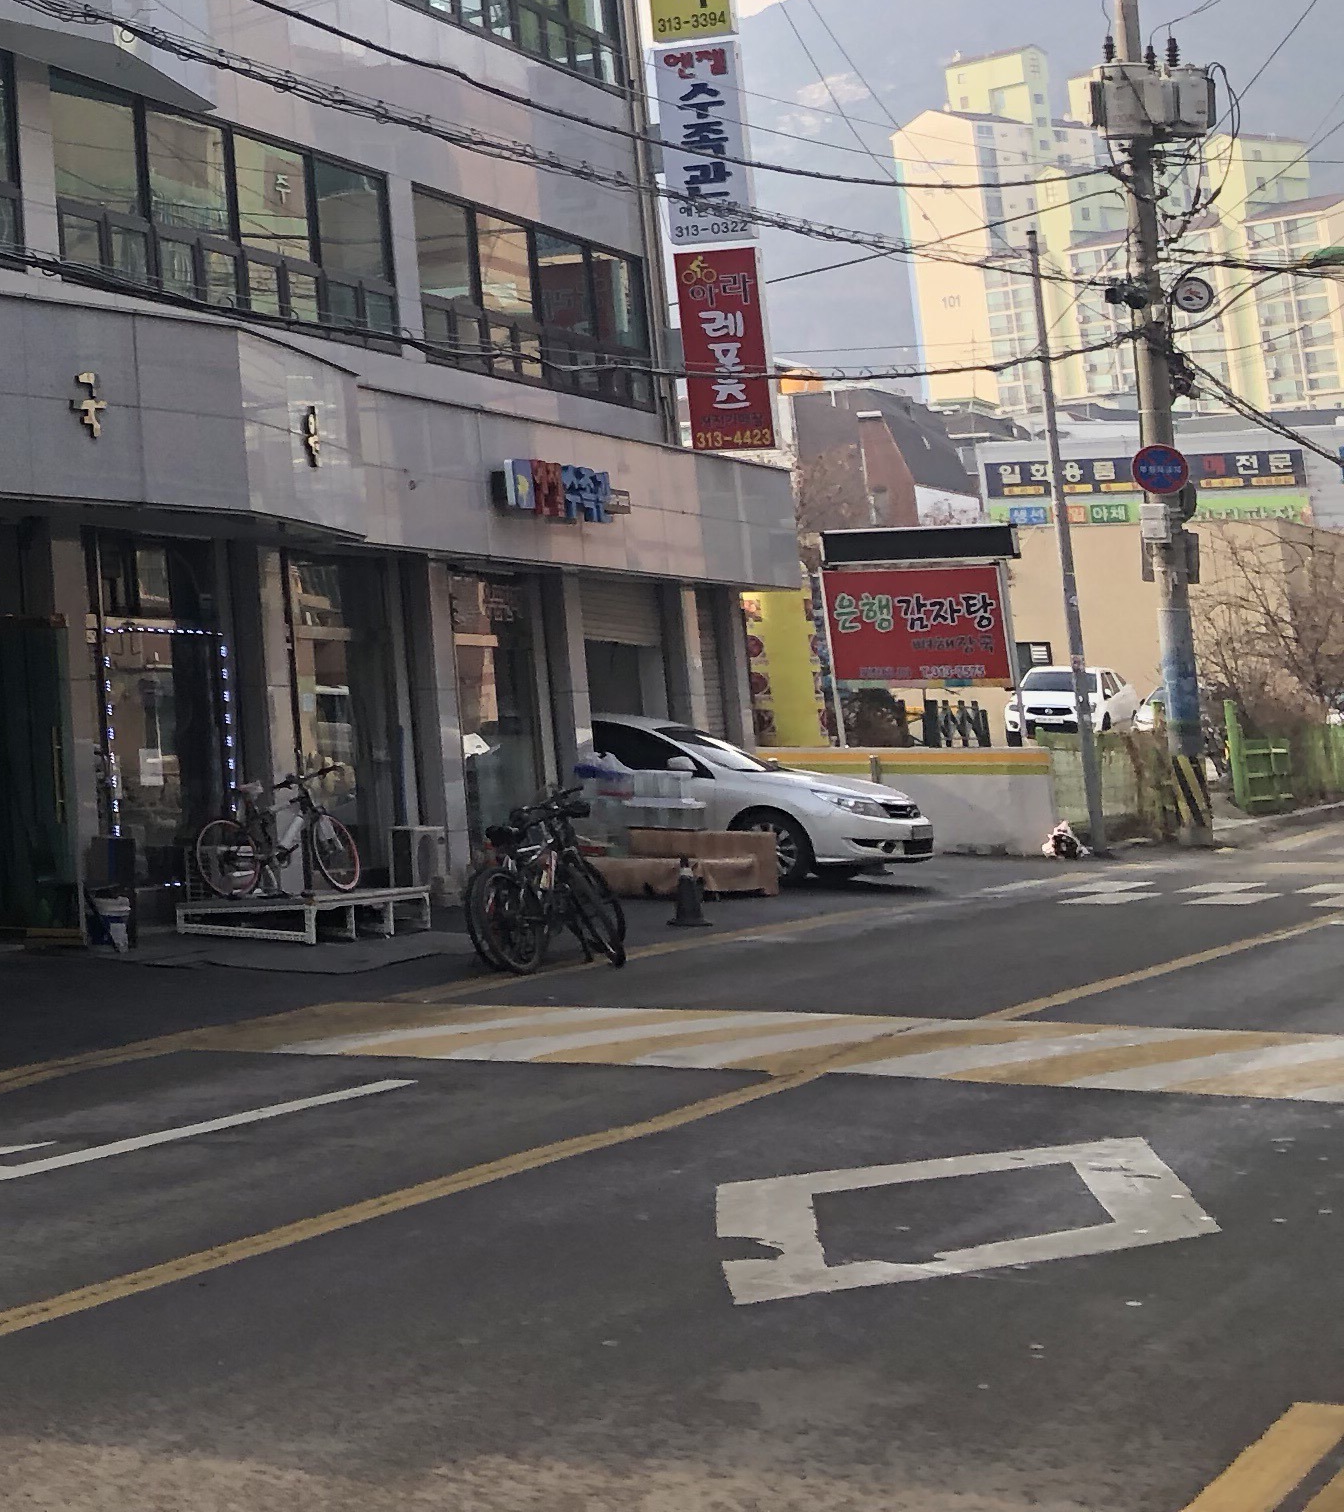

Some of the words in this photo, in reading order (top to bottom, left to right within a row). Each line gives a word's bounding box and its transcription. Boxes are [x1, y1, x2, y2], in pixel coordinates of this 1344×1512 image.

[657, 10, 727, 34] 313-3394
[675, 82, 734, 200] 수족관
[674, 221, 749, 238] 313-0322
[698, 310, 752, 410] 레포츠
[696, 428, 772, 448] 313-4423
[1235, 453, 1293, 475] 전문
[834, 594, 893, 633] 은행
[896, 593, 996, 632] 감자탕
